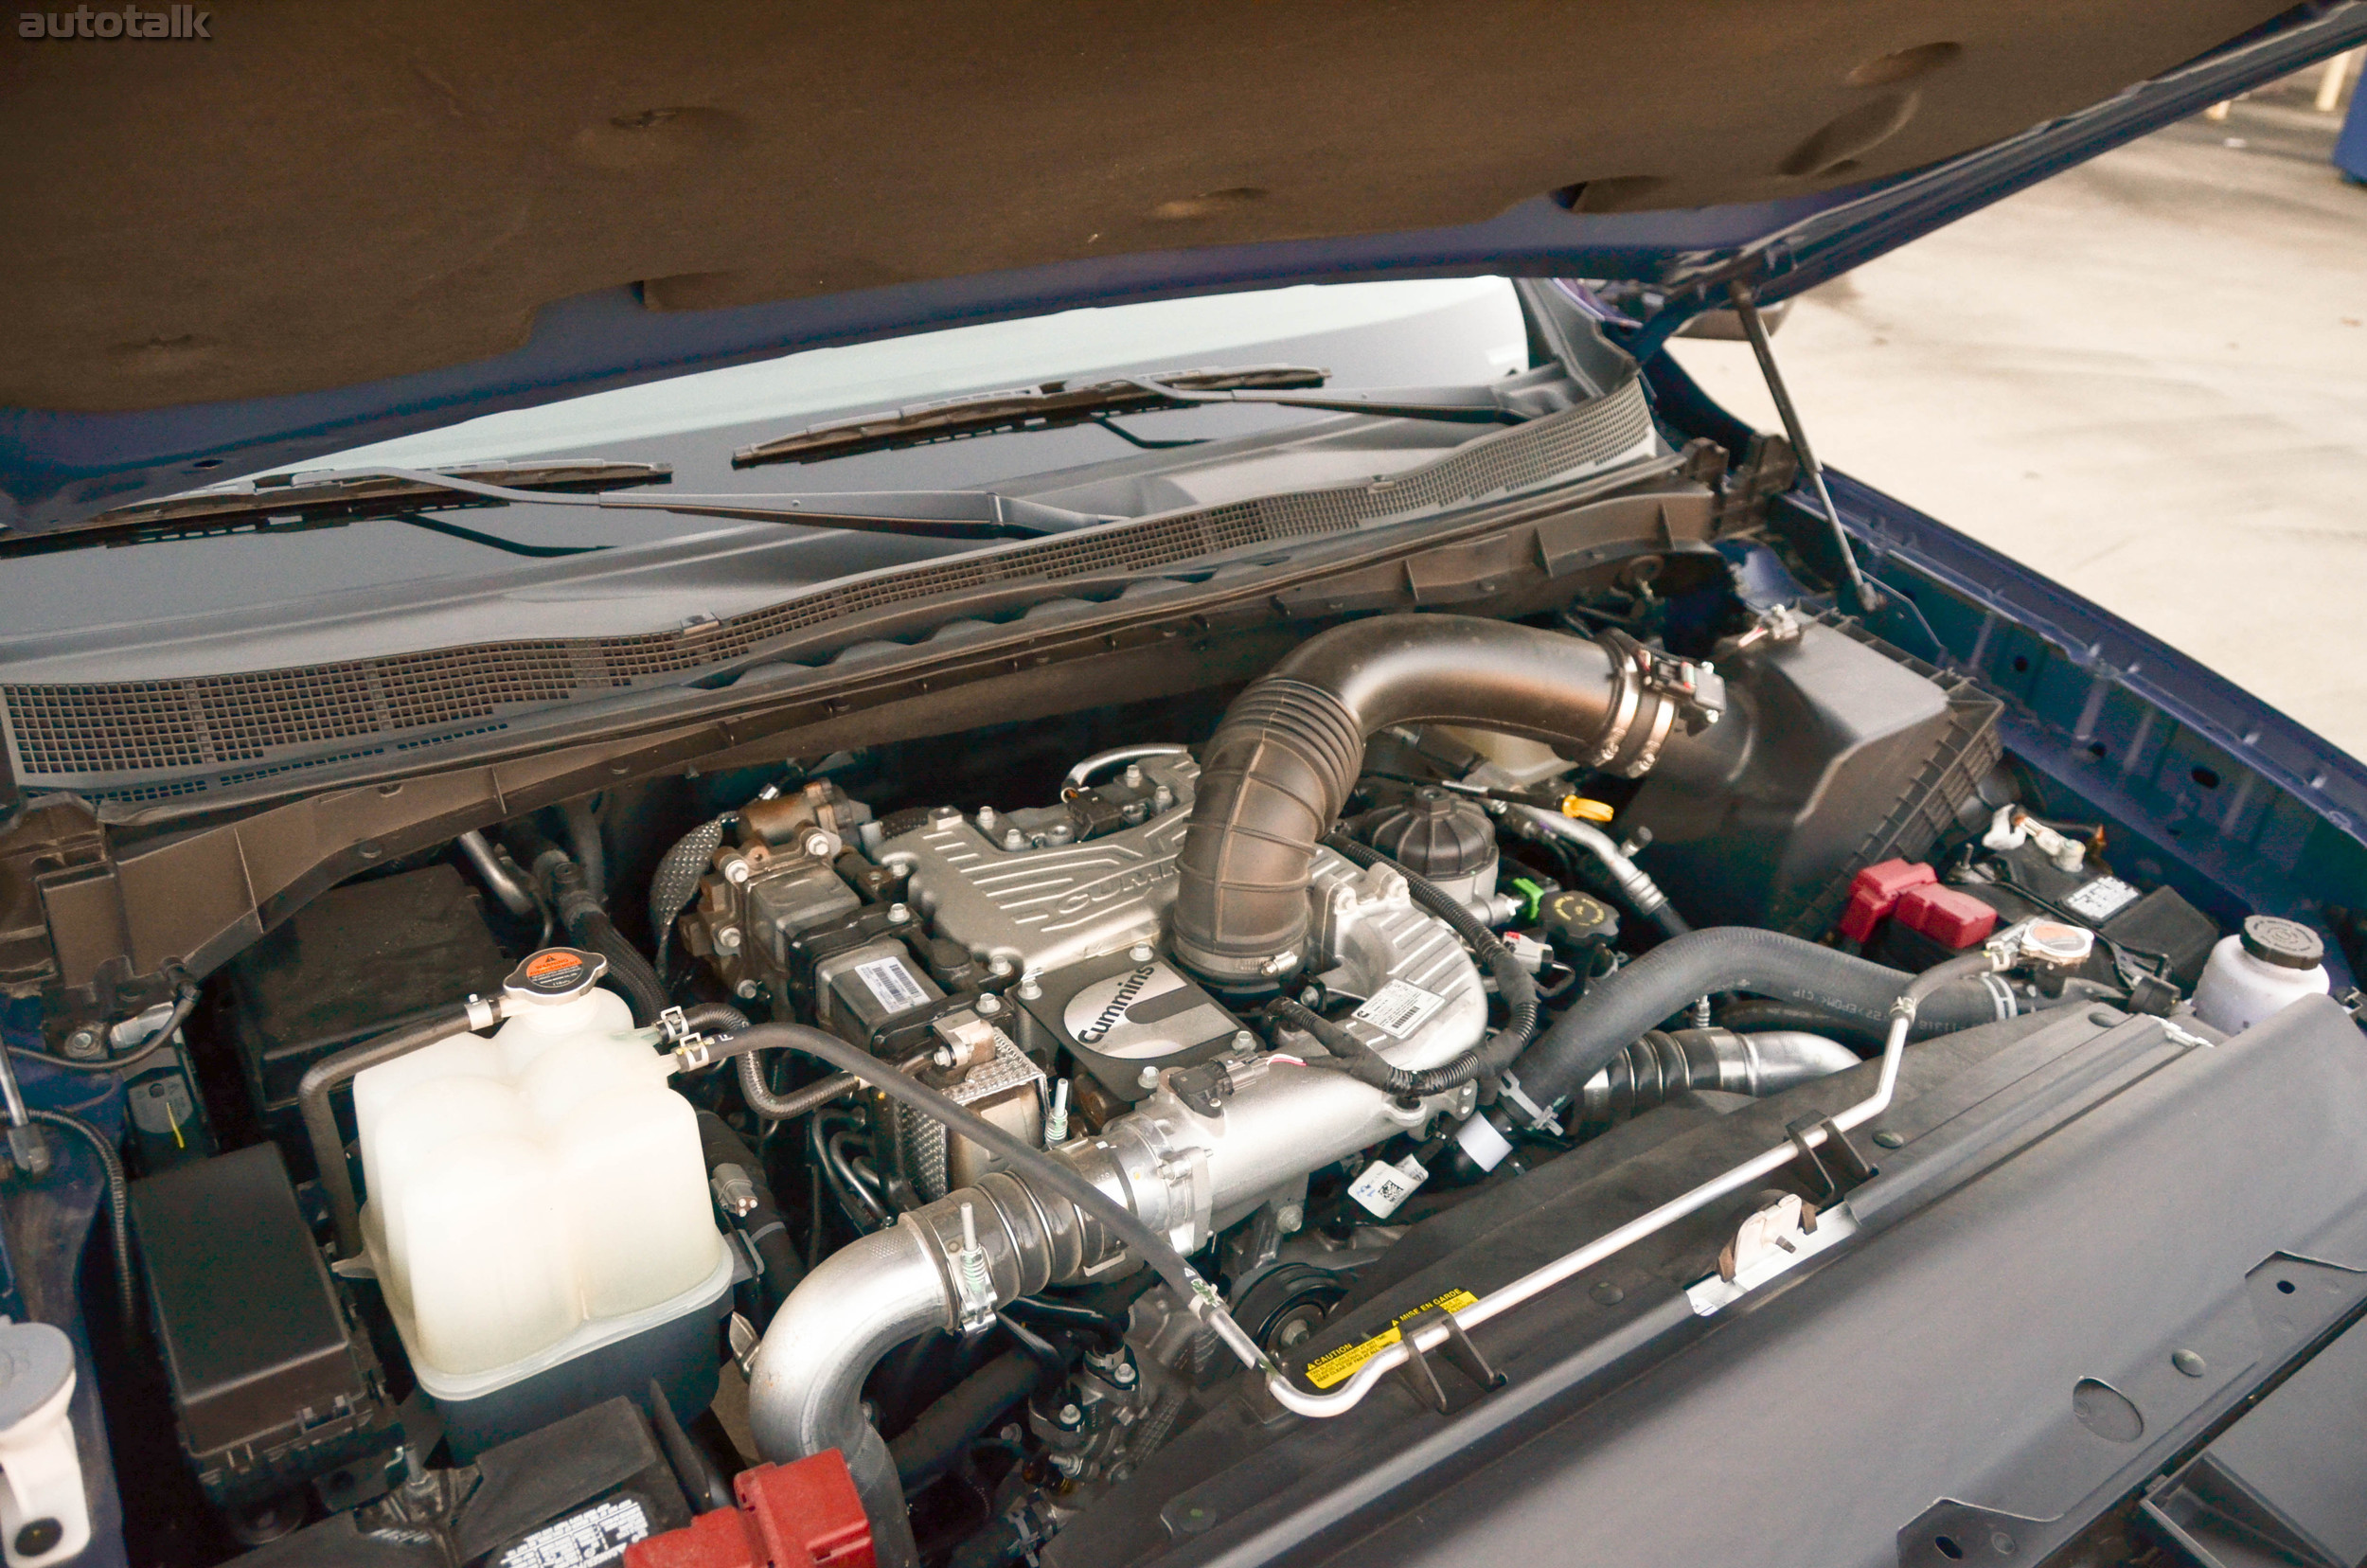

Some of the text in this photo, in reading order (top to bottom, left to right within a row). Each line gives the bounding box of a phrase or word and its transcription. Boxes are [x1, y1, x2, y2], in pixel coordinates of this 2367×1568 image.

[1077, 964, 1154, 1044] Cummins
[1399, 1307, 1419, 1322] MISE
[1420, 1301, 1433, 1312] EN
[1433, 1288, 1463, 1306] GARDE
[1314, 1343, 1353, 1366] CAUTION
